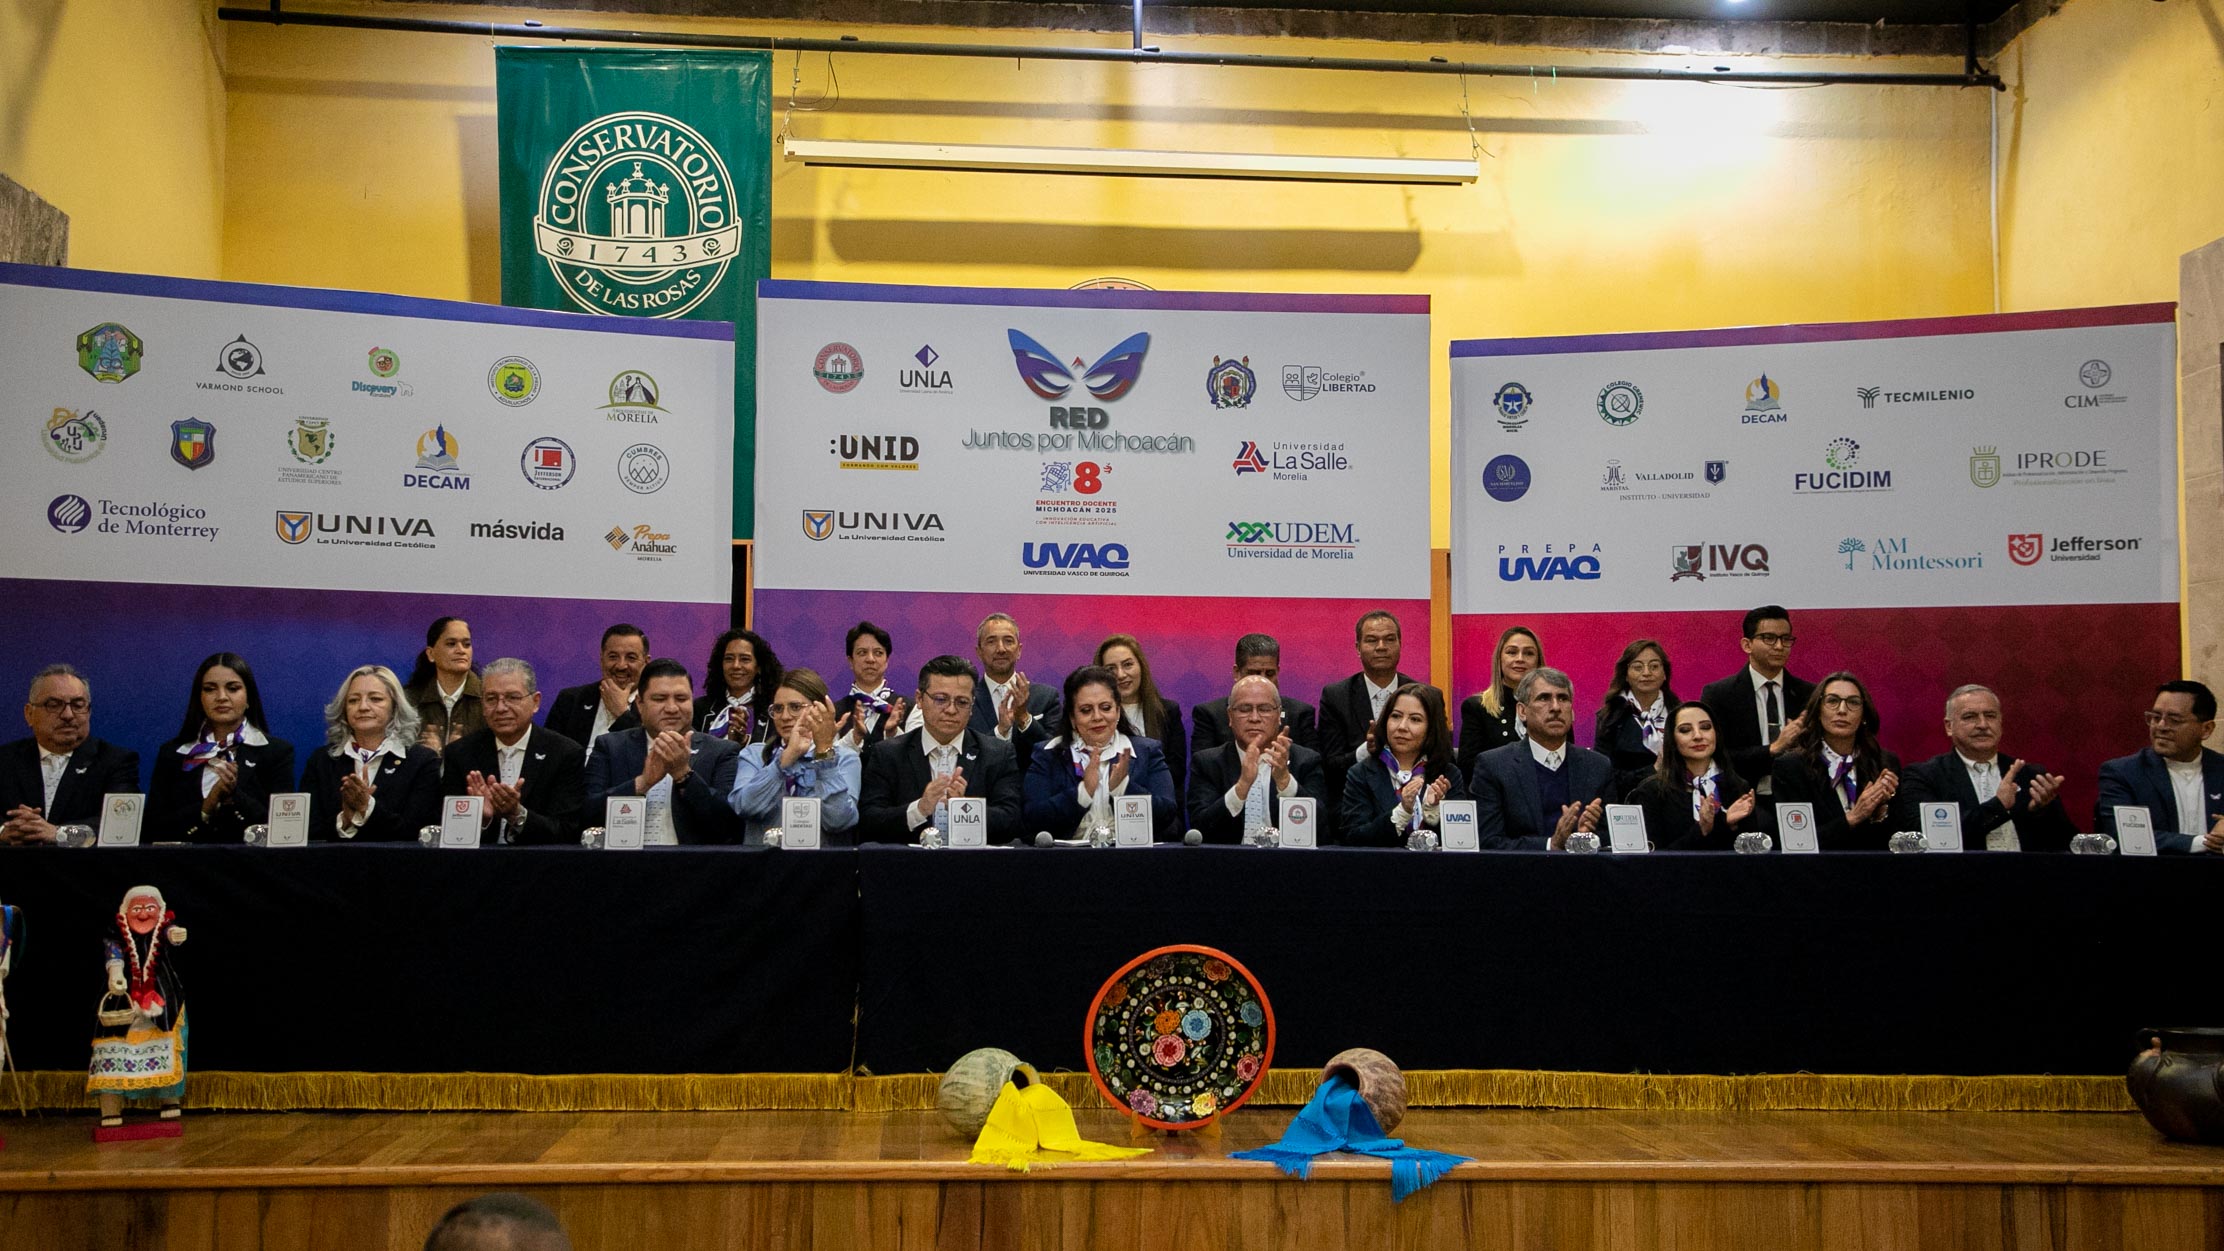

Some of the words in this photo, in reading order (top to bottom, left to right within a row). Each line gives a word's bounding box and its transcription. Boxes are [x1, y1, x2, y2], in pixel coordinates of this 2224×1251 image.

[552, 124, 724, 229] CONSERVATORIO
[588, 244, 688, 263] 1743
[575, 269, 604, 296] DE
[603, 287, 639, 309] LAS
[642, 269, 701, 309] ROSAS
[900, 369, 953, 389] UNLA
[1322, 372, 1360, 383] Colegio
[195, 381, 244, 393] VARMOND
[246, 384, 285, 395] SCHOOL
[352, 380, 397, 395] Discovery
[1322, 383, 1376, 393] LIBERTAD
[1606, 381, 1633, 390] COLEGIO
[1884, 388, 1975, 403] TECMILENIO
[2065, 395, 2100, 408] CIM
[606, 412, 658, 424] MORELIA
[1049, 406, 1109, 430] RED
[1741, 413, 1788, 424] DECAM
[962, 427, 1031, 449] Juntos
[1037, 433, 1073, 452] por
[1077, 430, 1194, 452] Michoacán
[1273, 441, 1345, 451] Universidad
[626, 447, 662, 461] CUMBRES
[2017, 450, 2106, 470] IPRODE
[404, 473, 470, 490] DECAM
[1273, 472, 1308, 481] Morelia
[1635, 472, 1694, 481] VALLADOLID
[1795, 470, 1891, 490] FUCIDIM
[1035, 499, 1081, 507] ENCUENTRO
[1662, 492, 1710, 500] UNIVERSIDAD
[98, 500, 206, 521] Tecnológico
[1035, 505, 1091, 513] MICHOACÁN
[317, 514, 435, 537] UNIVA
[839, 512, 944, 531] UNIVA
[98, 519, 120, 534] de
[125, 520, 219, 542] Monterrey
[470, 519, 564, 541] másvida
[633, 524, 670, 541] Prepa
[1274, 522, 1354, 544] UDEM
[317, 537, 330, 545] La
[332, 538, 391, 547] Universidad
[394, 540, 436, 549] Católica
[907, 534, 945, 542] Católica
[1872, 537, 1908, 554] AM
[2050, 536, 2140, 553] Jefferson
[631, 541, 677, 554] Anáhuac
[1227, 547, 1291, 559] Universidad
[1294, 547, 1309, 559] de
[1311, 548, 1354, 559] Morelia
[1499, 543, 1602, 554] PREPA
[1023, 542, 1130, 569] UVAQ
[1709, 543, 1770, 573] IVQ
[1872, 551, 1983, 571] Montessori
[2050, 553, 2101, 563] Universidad
[1499, 555, 1602, 581] UVAQ
[953, 814, 980, 824] UNLA
[1445, 813, 1472, 822] UVAQ
